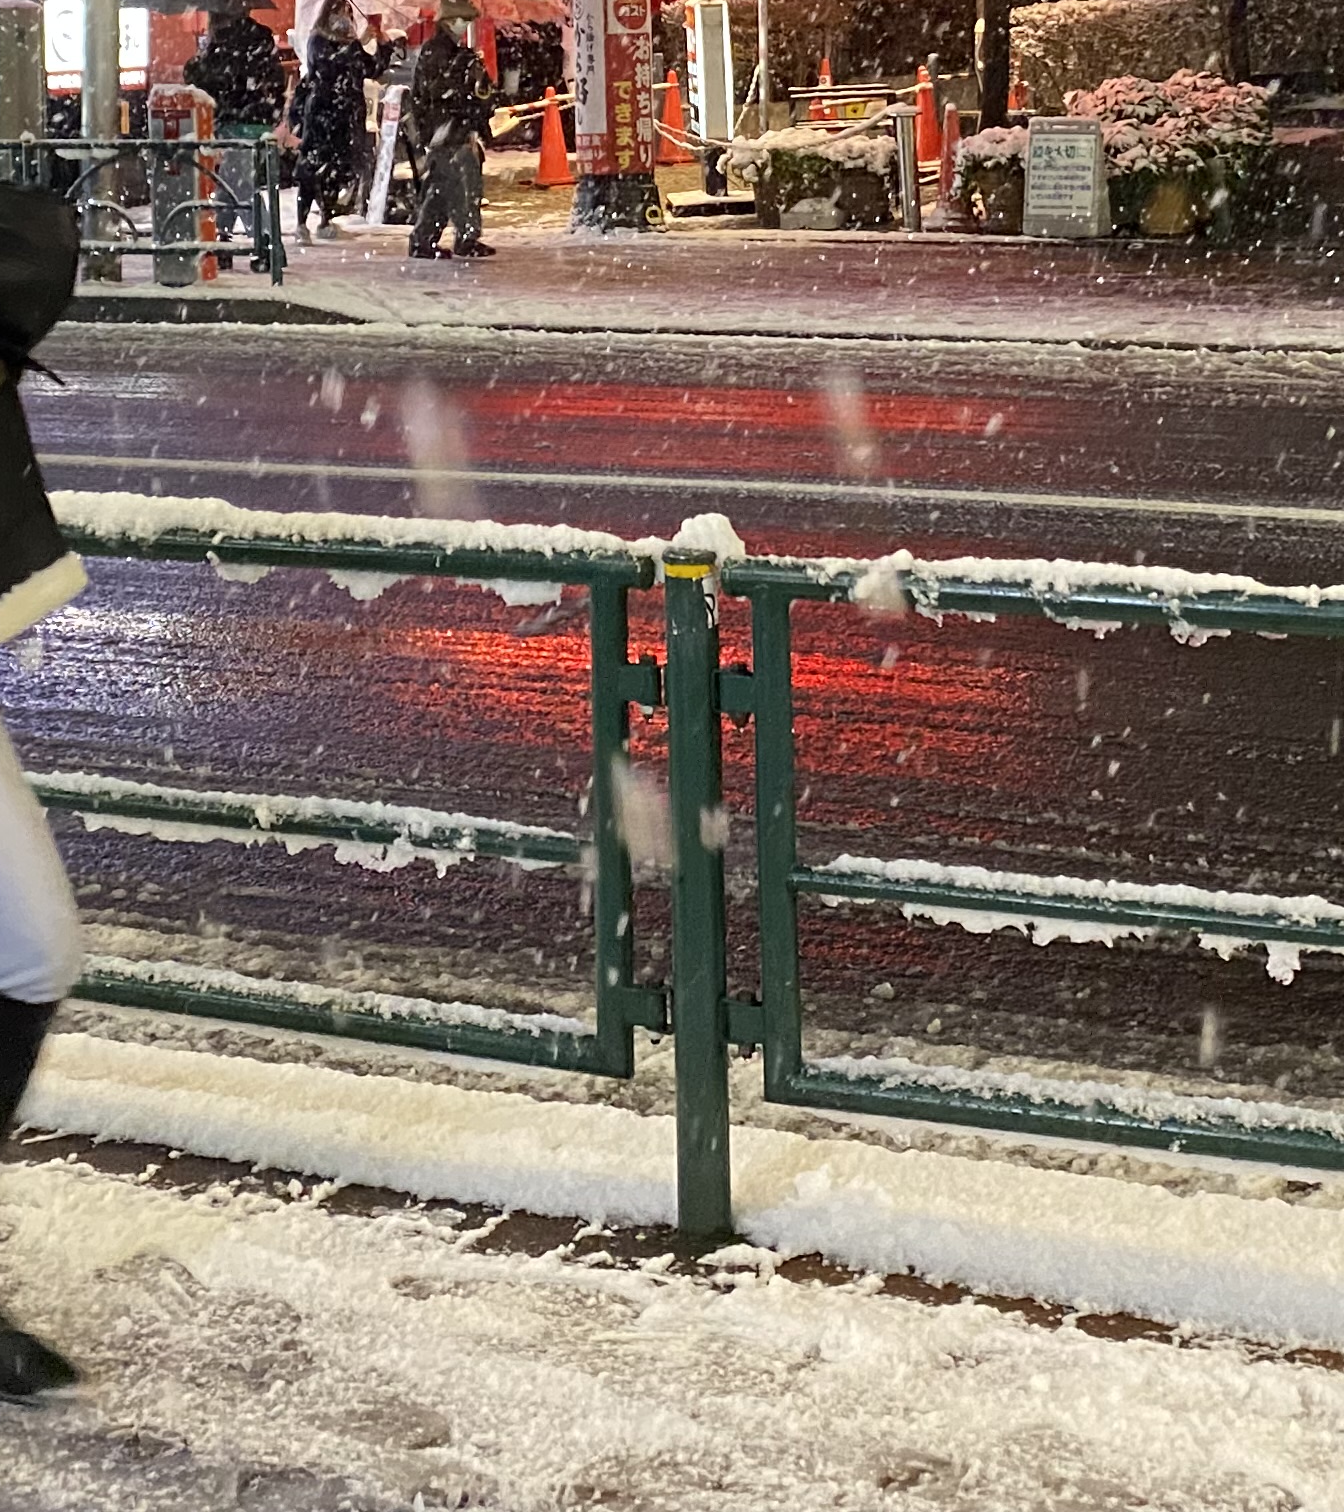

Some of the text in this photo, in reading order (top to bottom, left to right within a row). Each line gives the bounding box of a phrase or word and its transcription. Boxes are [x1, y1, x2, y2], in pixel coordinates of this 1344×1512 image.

[618, 4, 647, 18] ガスト
[613, 80, 636, 170] できます
[633, 34, 652, 169] お持ち帰り
